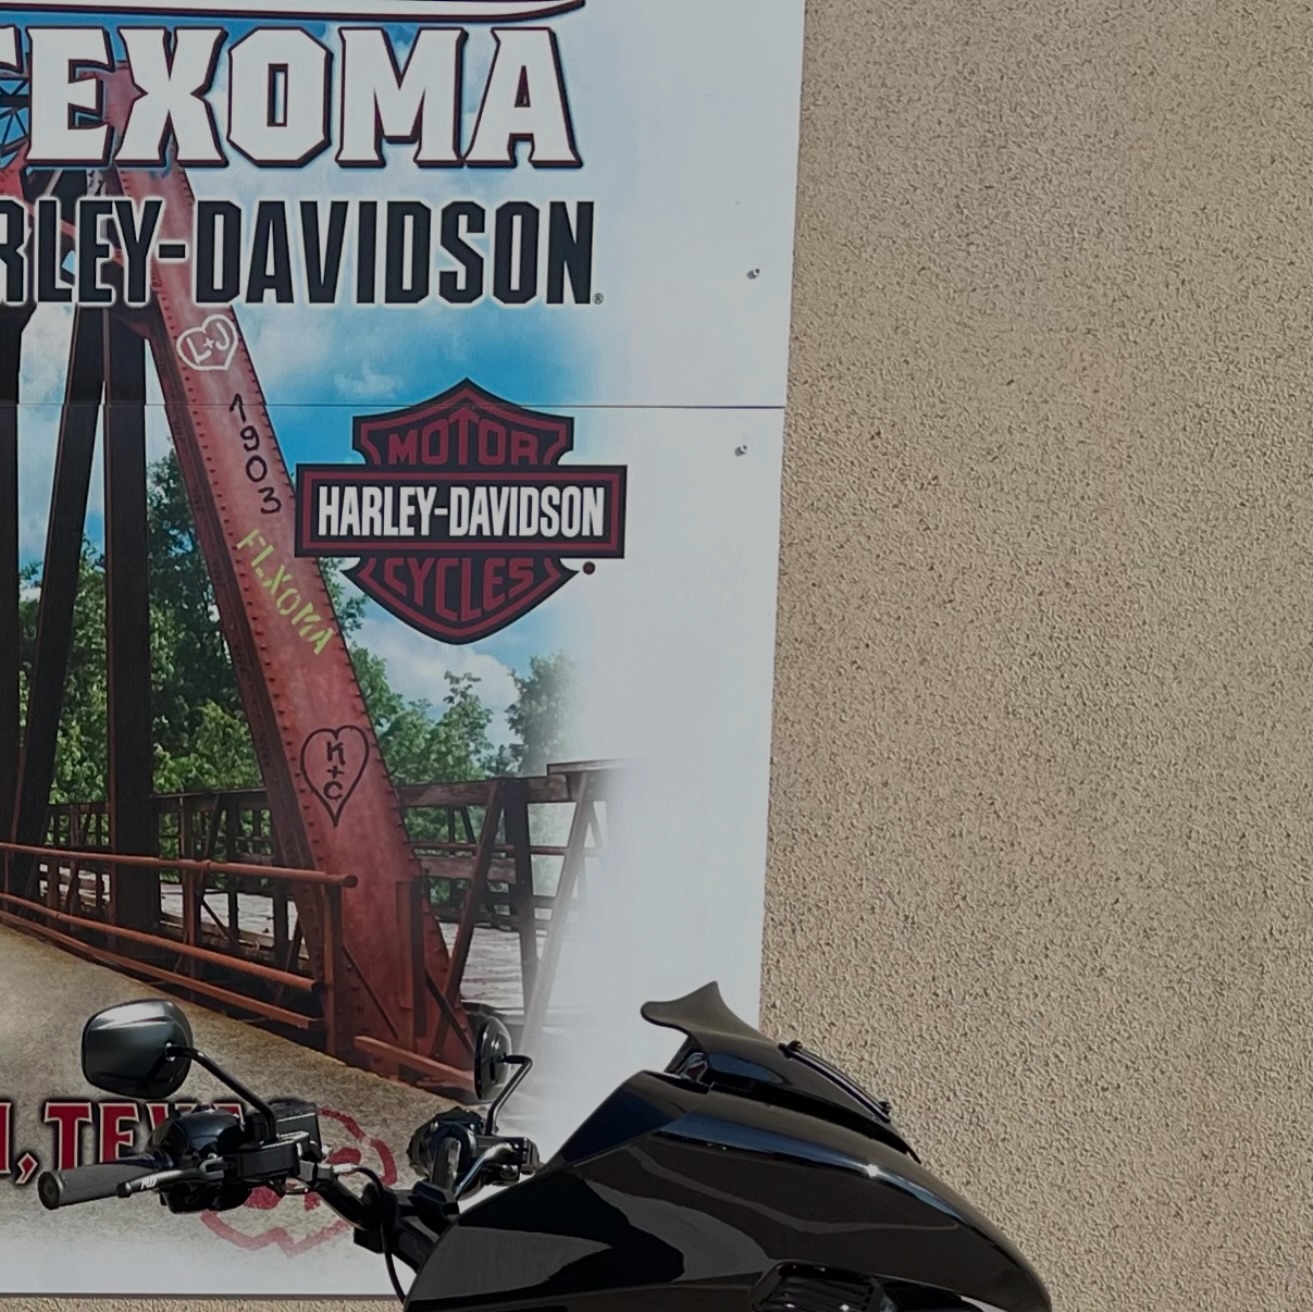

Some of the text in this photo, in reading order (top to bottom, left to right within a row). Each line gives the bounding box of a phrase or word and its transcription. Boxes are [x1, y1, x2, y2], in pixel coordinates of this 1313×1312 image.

[229, 393, 282, 514] 1903
[388, 407, 539, 466] MOTOR
[318, 486, 605, 538] HARLEY-DAVIDSON
[384, 557, 534, 622] CYCLES
